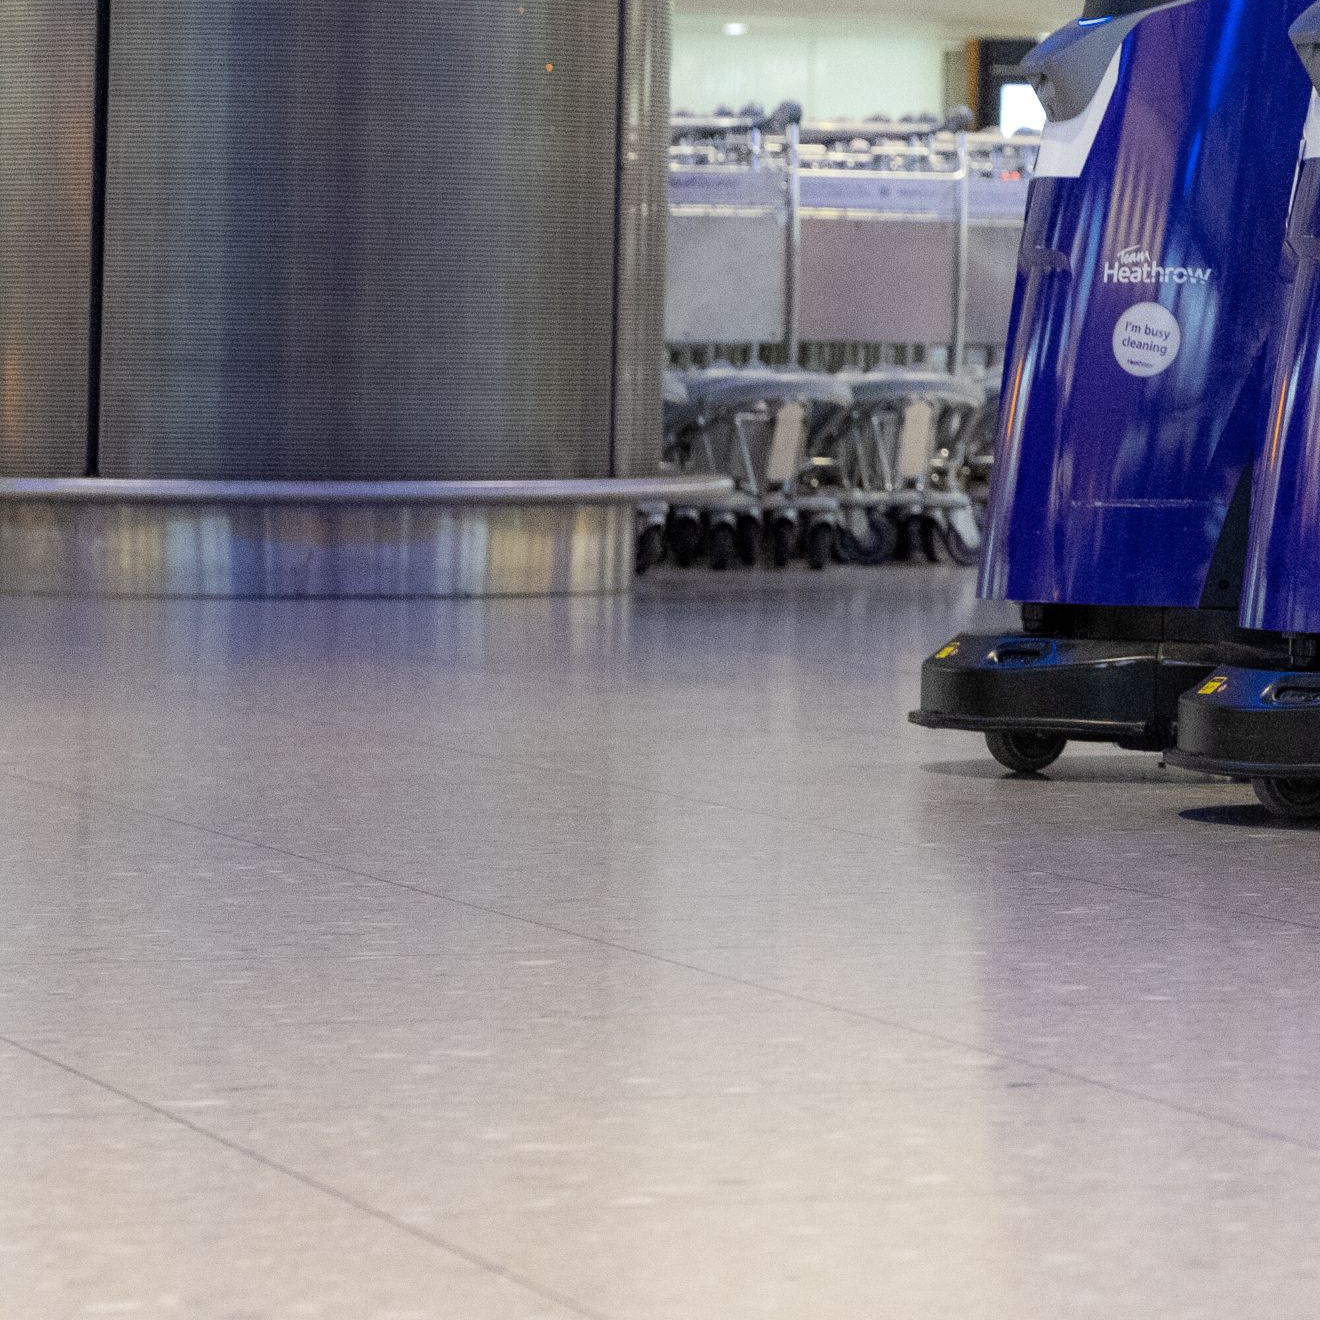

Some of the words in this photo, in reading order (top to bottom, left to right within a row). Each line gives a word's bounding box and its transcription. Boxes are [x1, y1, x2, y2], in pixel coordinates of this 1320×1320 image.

[1117, 245, 1150, 264] Team
[1103, 261, 1212, 284] Heathrow
[1125, 321, 1141, 332] I'm
[1144, 324, 1171, 341] busy
[1122, 337, 1167, 356] cleaning
